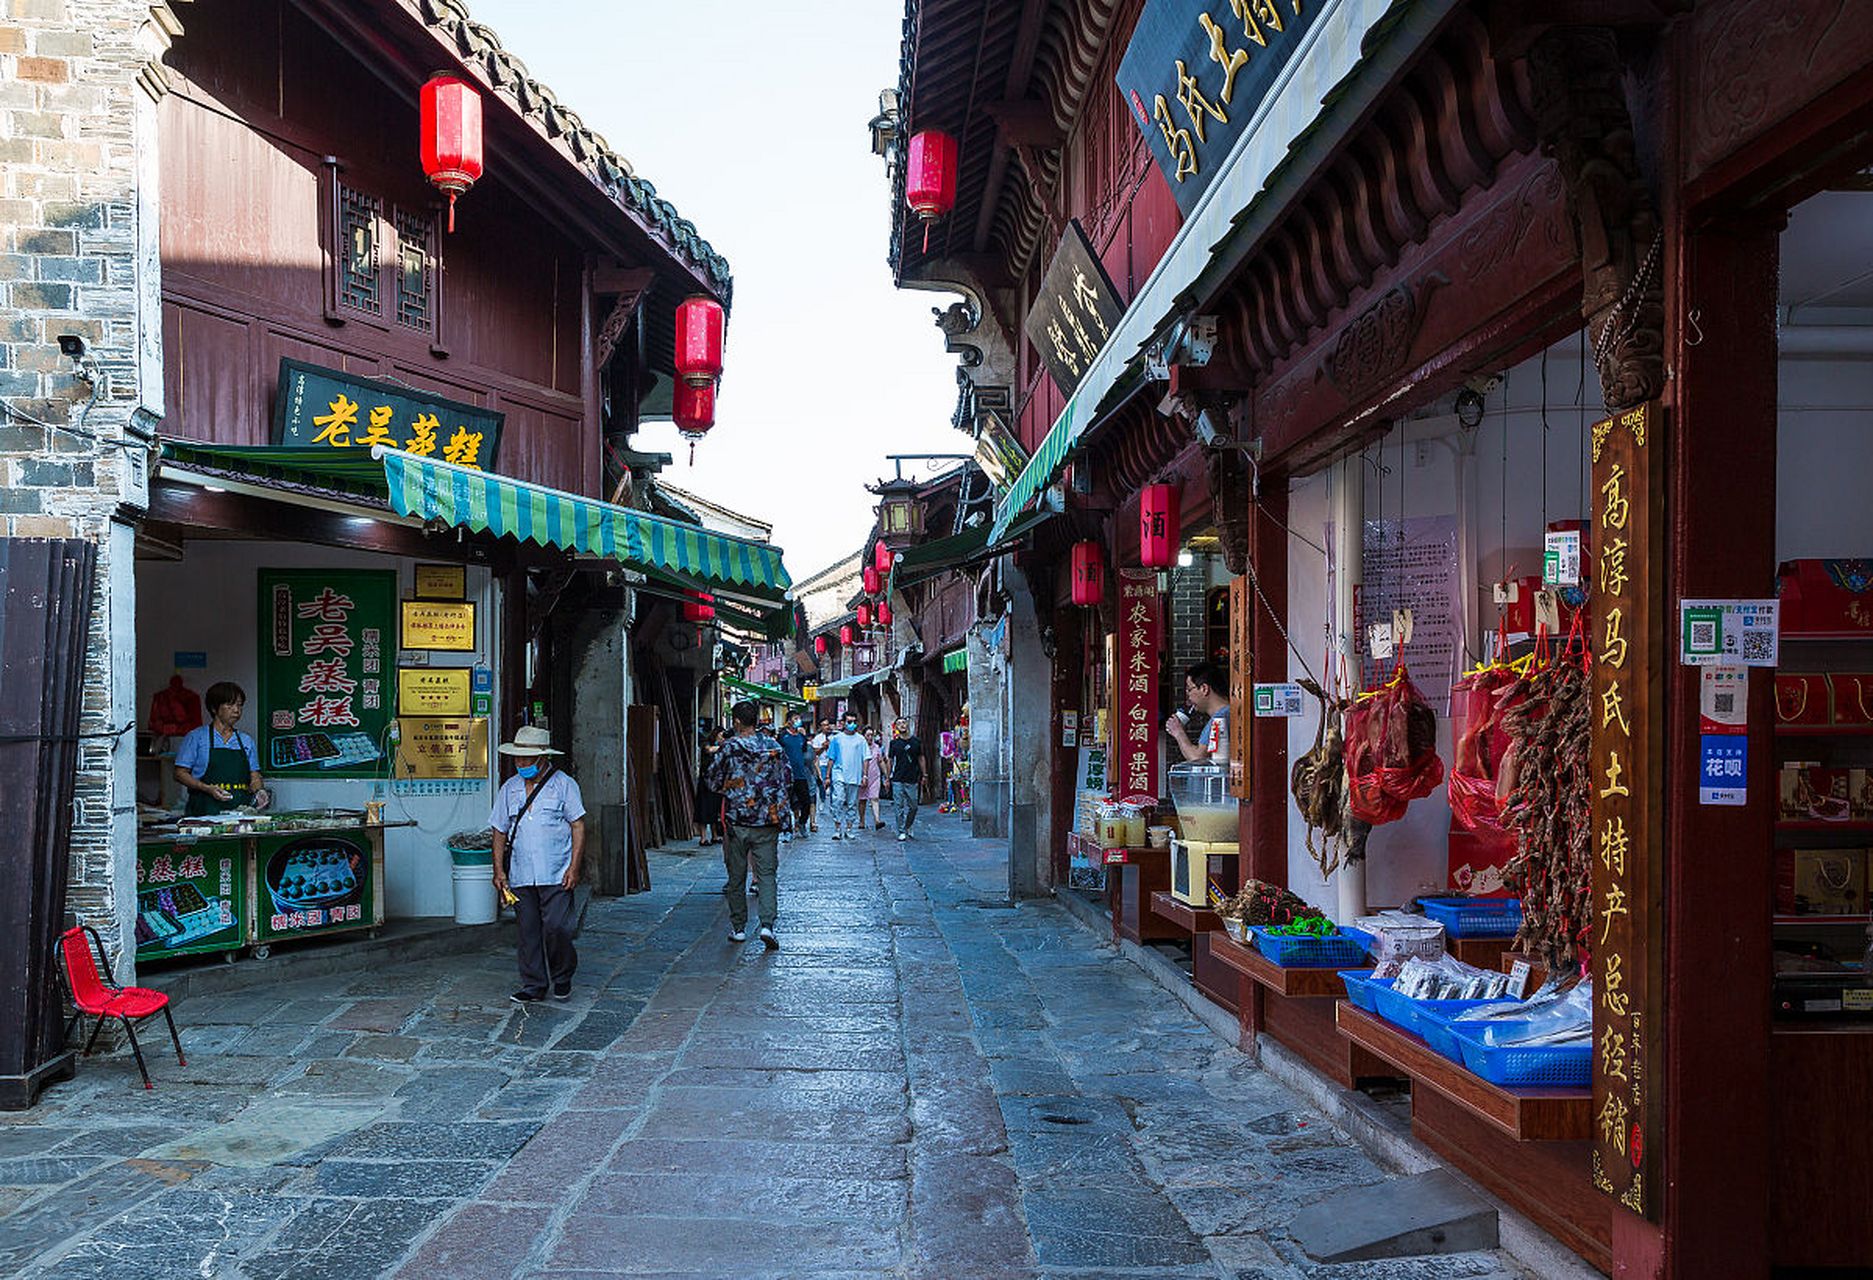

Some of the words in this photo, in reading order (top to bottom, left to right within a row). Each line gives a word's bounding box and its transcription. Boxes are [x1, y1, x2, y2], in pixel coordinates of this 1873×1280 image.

[311, 393, 484, 472] 老吴蒸糕
[1142, 511, 1165, 540] 酒
[1076, 560, 1099, 585] 酒
[298, 587, 360, 728] 老吴蒸糕
[362, 628, 380, 673] 糯米团
[362, 678, 380, 709] 青团
[1705, 757, 1743, 777] 花呗
[1597, 464, 1630, 1157] 高淳马氏土特产总经销
[271, 909, 322, 931] 糯米团
[330, 904, 362, 924] 青团
